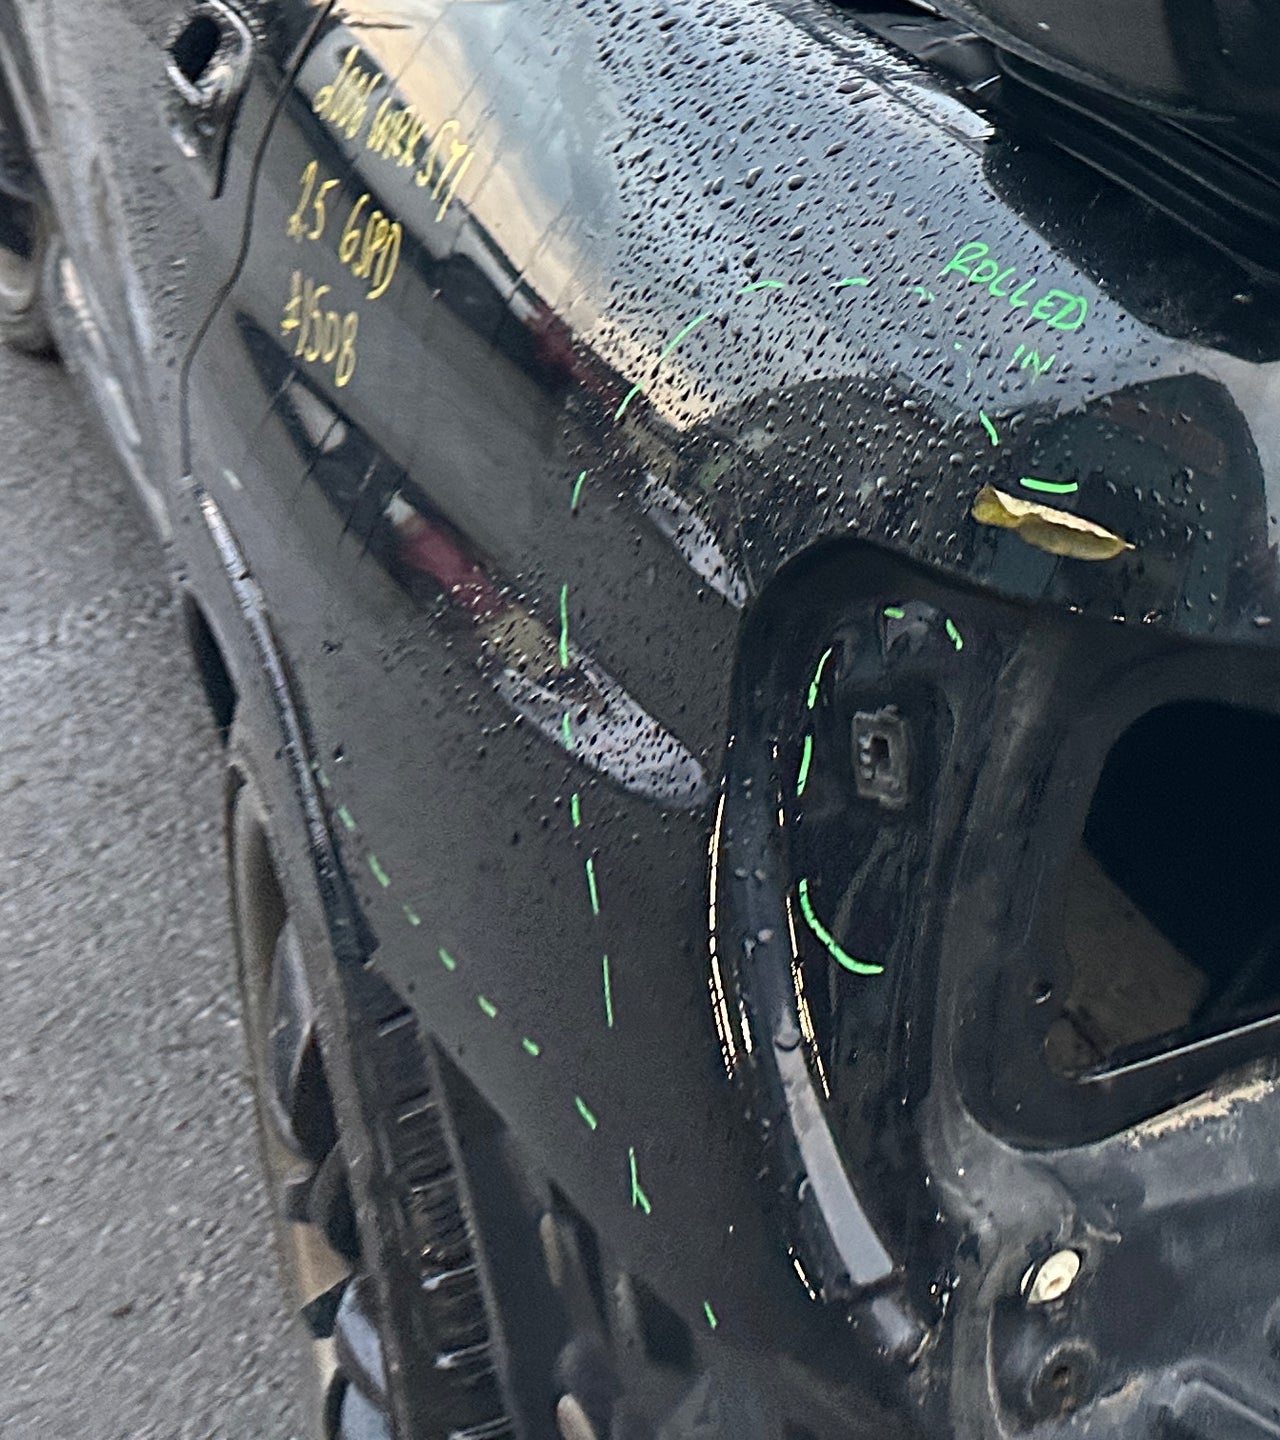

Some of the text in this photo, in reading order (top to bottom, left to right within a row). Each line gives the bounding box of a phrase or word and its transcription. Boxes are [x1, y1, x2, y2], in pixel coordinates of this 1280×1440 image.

[365, 96, 430, 168] WRX
[939, 240, 1090, 332] ROLLED
[1012, 343, 1057, 386] IN
